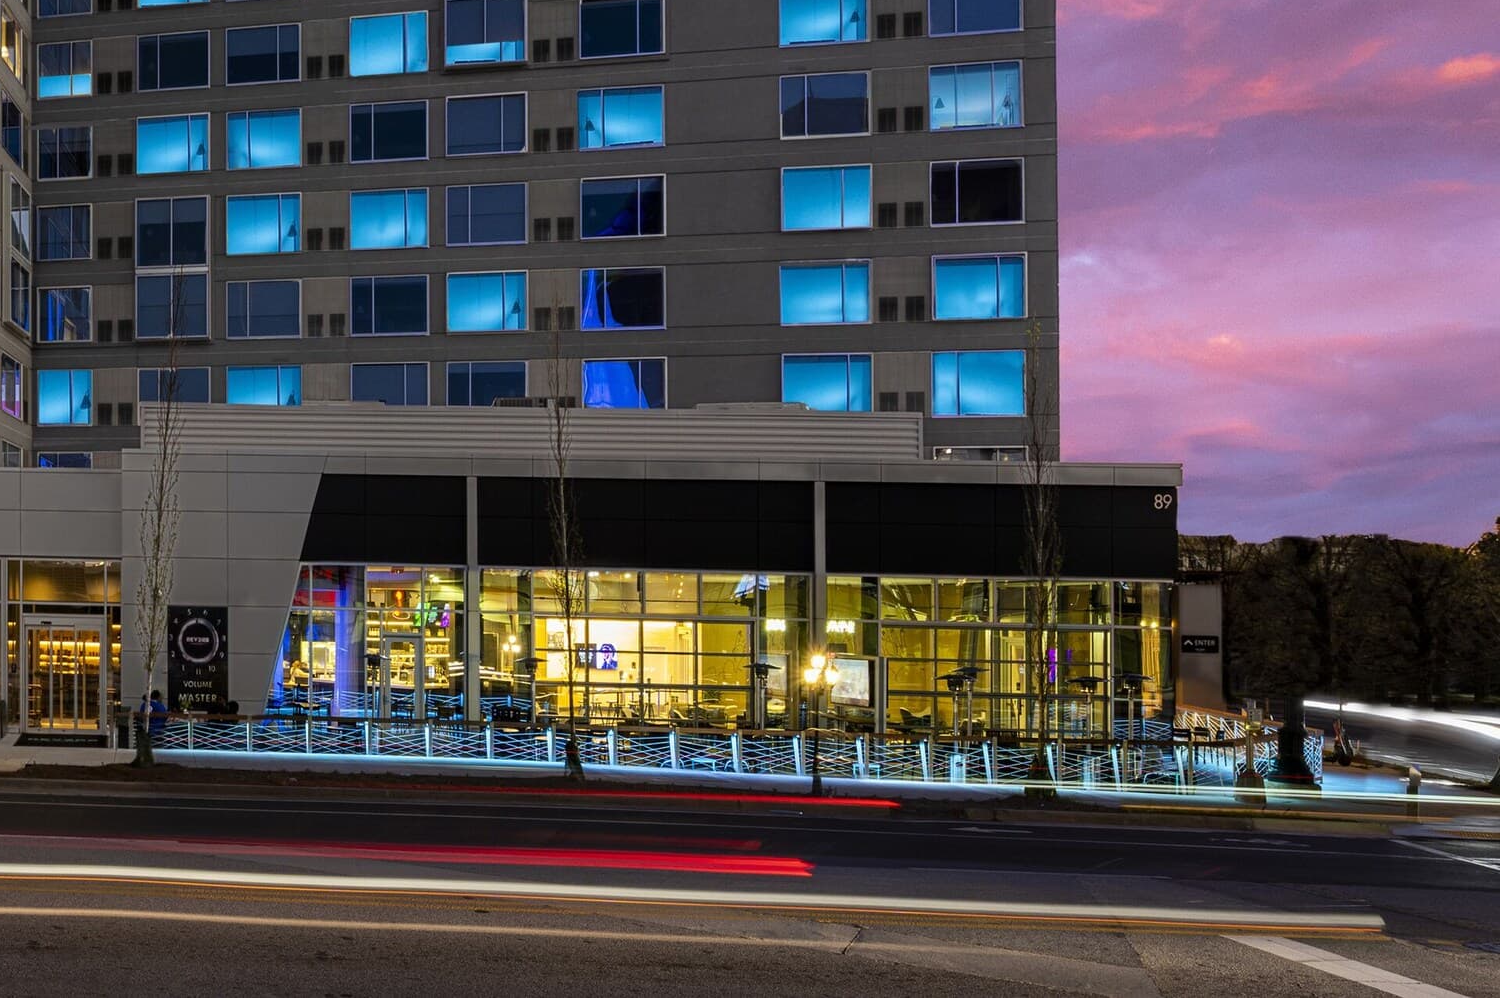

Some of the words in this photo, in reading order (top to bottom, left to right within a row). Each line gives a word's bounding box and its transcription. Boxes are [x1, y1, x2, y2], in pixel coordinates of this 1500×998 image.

[1154, 494, 1173, 510] 89
[182, 680, 213, 689] VOLUME
[179, 693, 217, 702] MASTER
